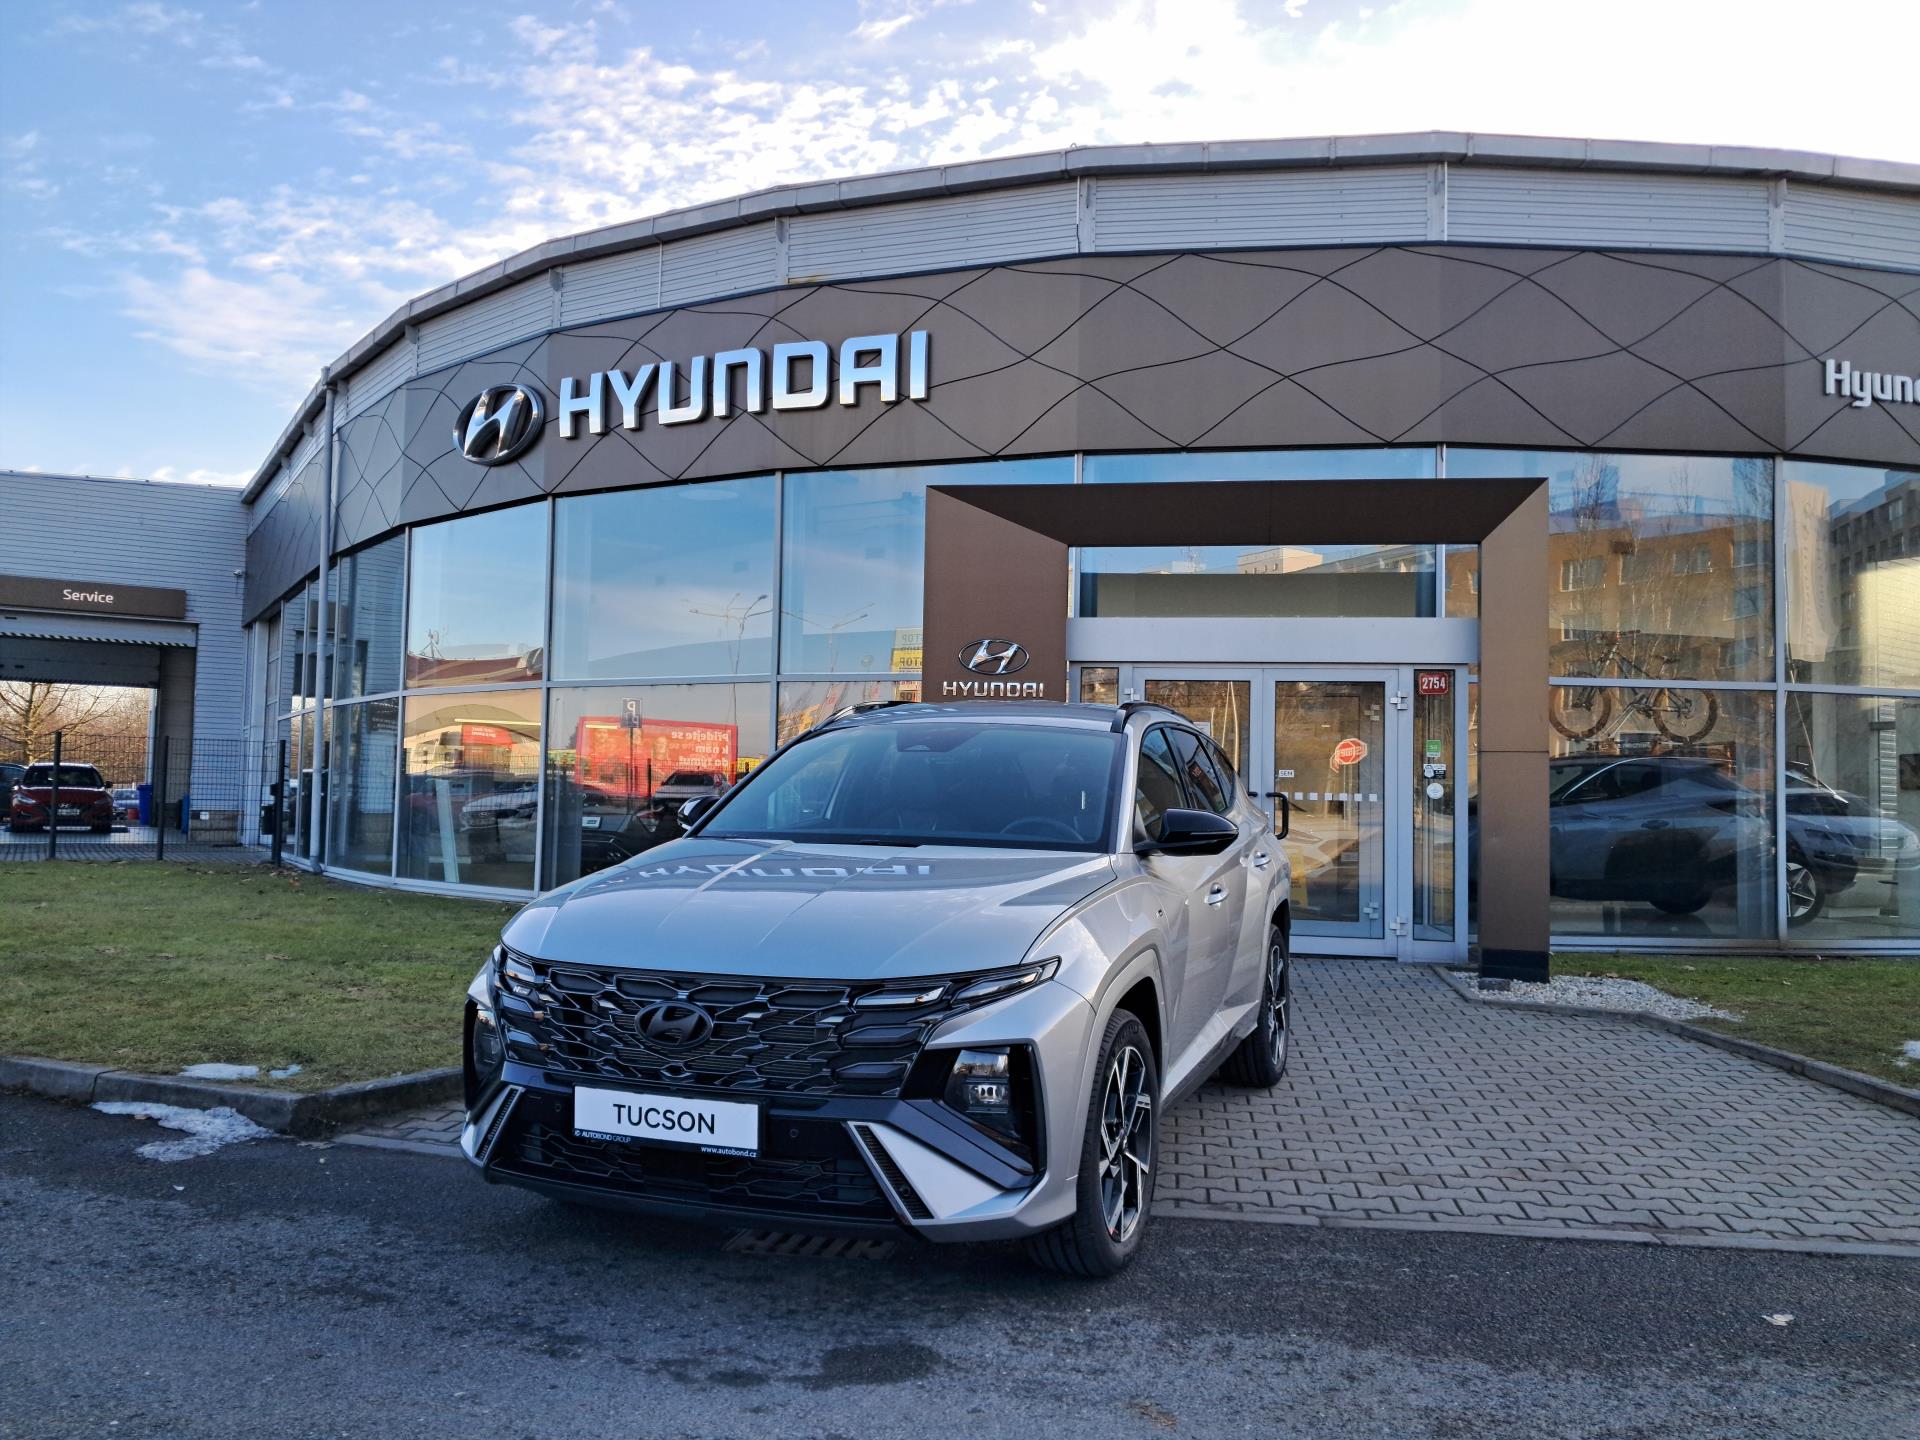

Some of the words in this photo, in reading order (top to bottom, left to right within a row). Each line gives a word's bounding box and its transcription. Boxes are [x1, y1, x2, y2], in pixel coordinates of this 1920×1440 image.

[559, 330, 929, 439] HYUNDAI
[62, 589, 114, 603] Service
[942, 681, 1044, 697] HYUNDAI
[1422, 677, 1446, 689] 2754
[613, 1103, 715, 1134] TUCSON
[581, 1131, 613, 1141] AUTOBOND
[700, 1146, 756, 1158] www.autobond.cz
